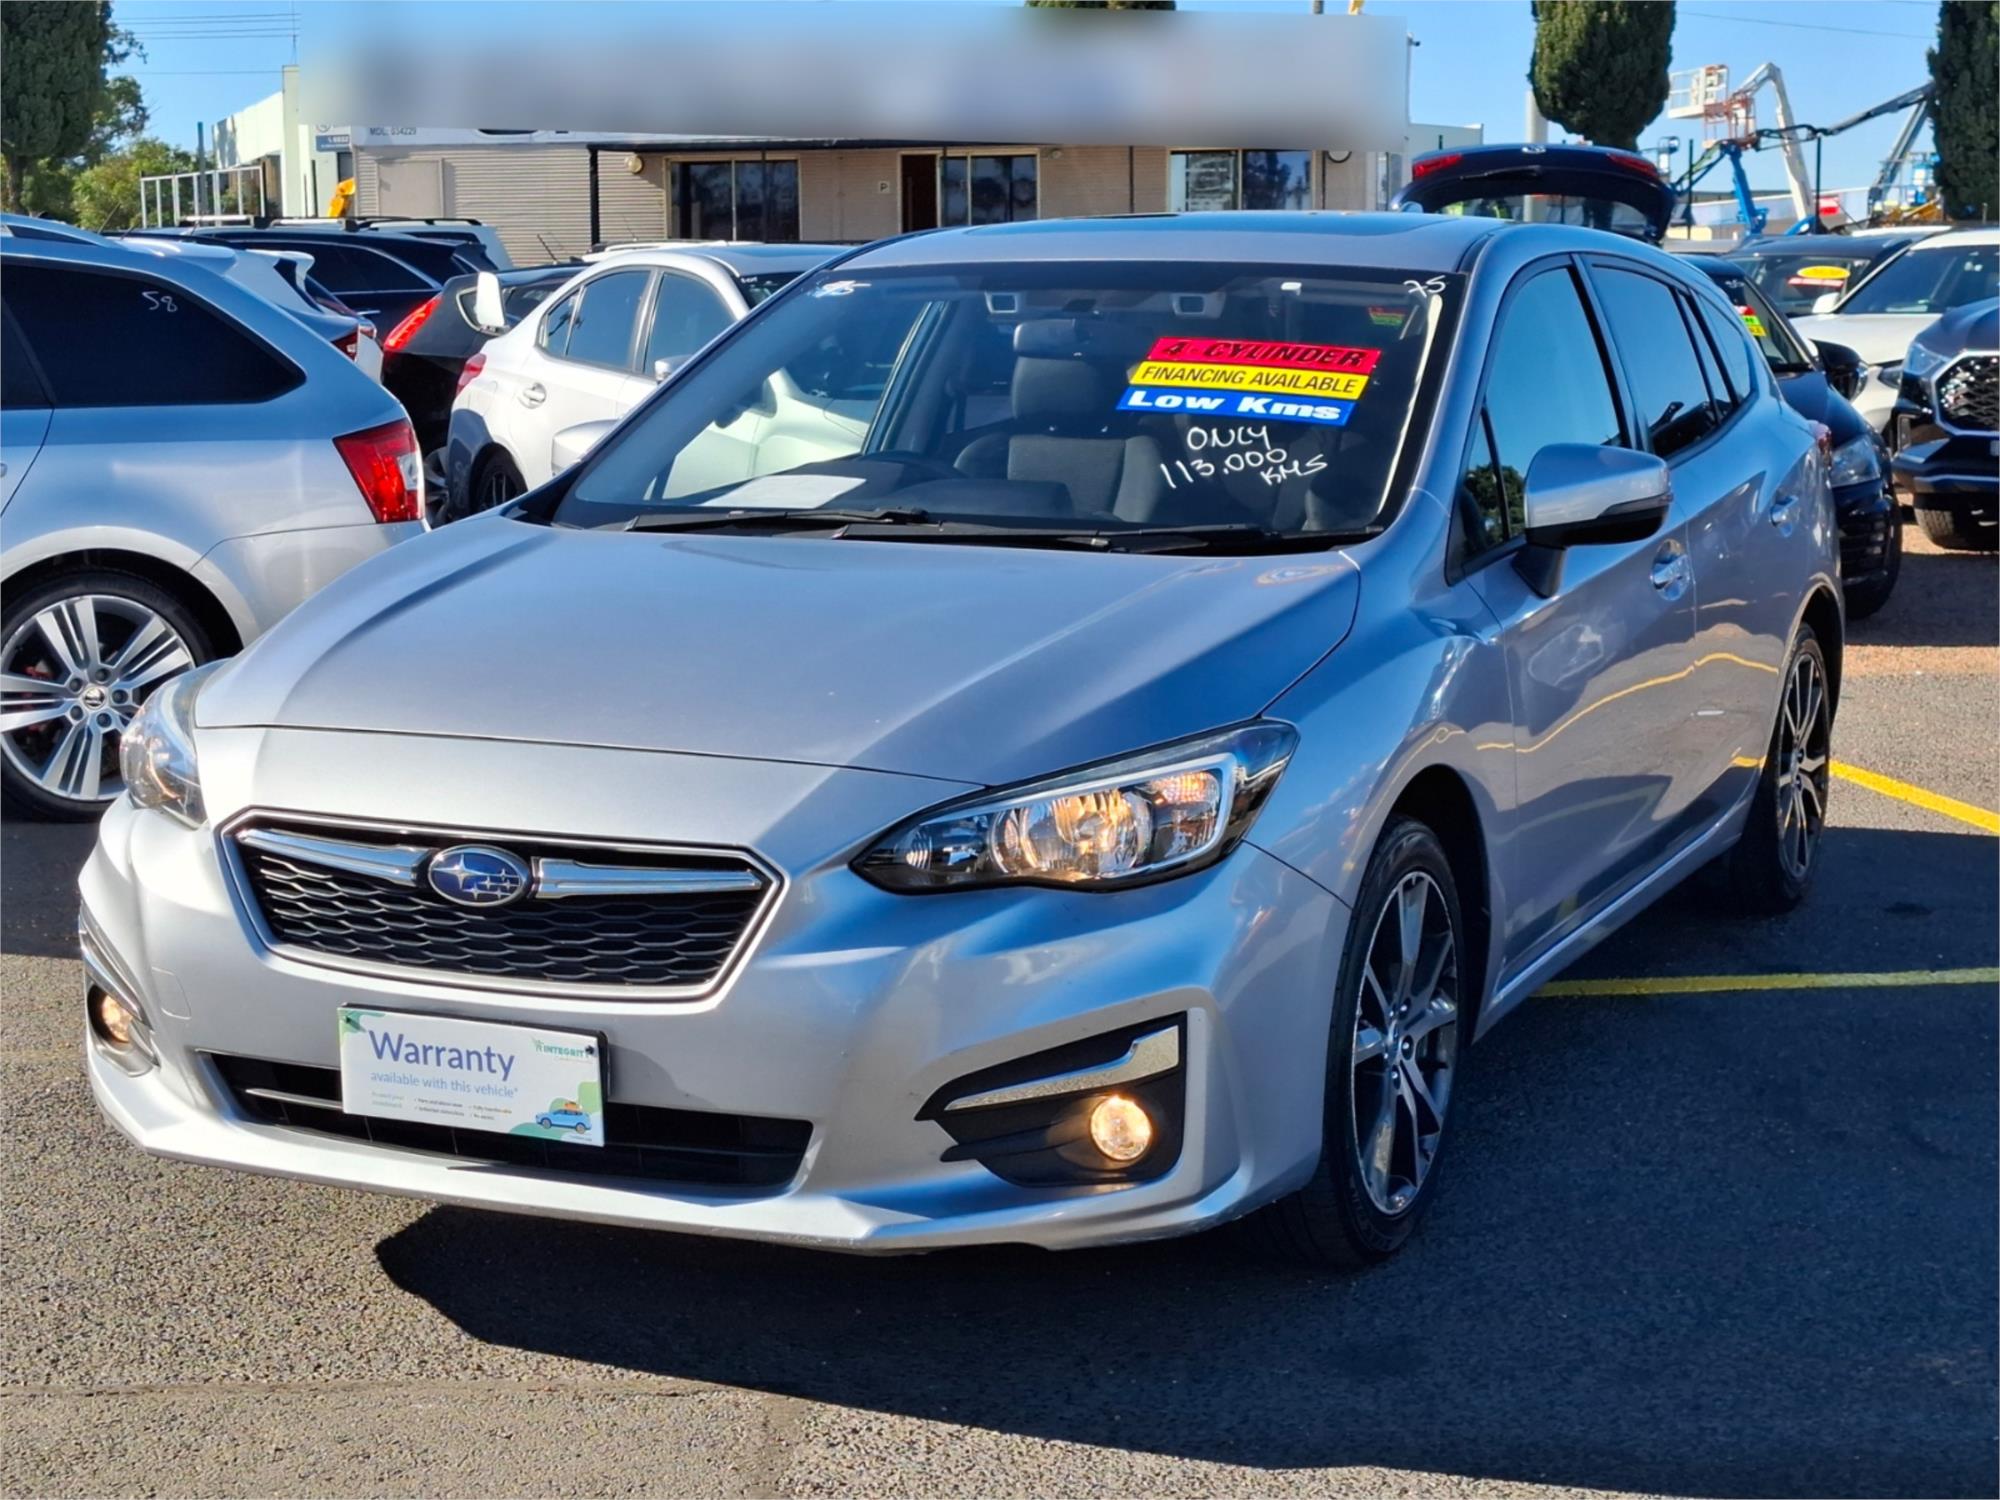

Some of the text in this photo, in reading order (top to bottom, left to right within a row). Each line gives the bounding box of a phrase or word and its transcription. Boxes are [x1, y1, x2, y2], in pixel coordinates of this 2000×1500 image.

[141, 291, 178, 313] 58
[1162, 342, 1184, 357] 4
[1203, 341, 1368, 367] CYLINDER
[1141, 365, 1359, 394] FINANCING AVAILABLE
[1127, 389, 1341, 420] Low Kms
[1186, 424, 1272, 451] ONLY
[1259, 453, 1329, 487] KMS
[368, 1029, 515, 1081] Warranty
[370, 1071, 420, 1087] available
[422, 1074, 449, 1091] with
[450, 1077, 471, 1094] this
